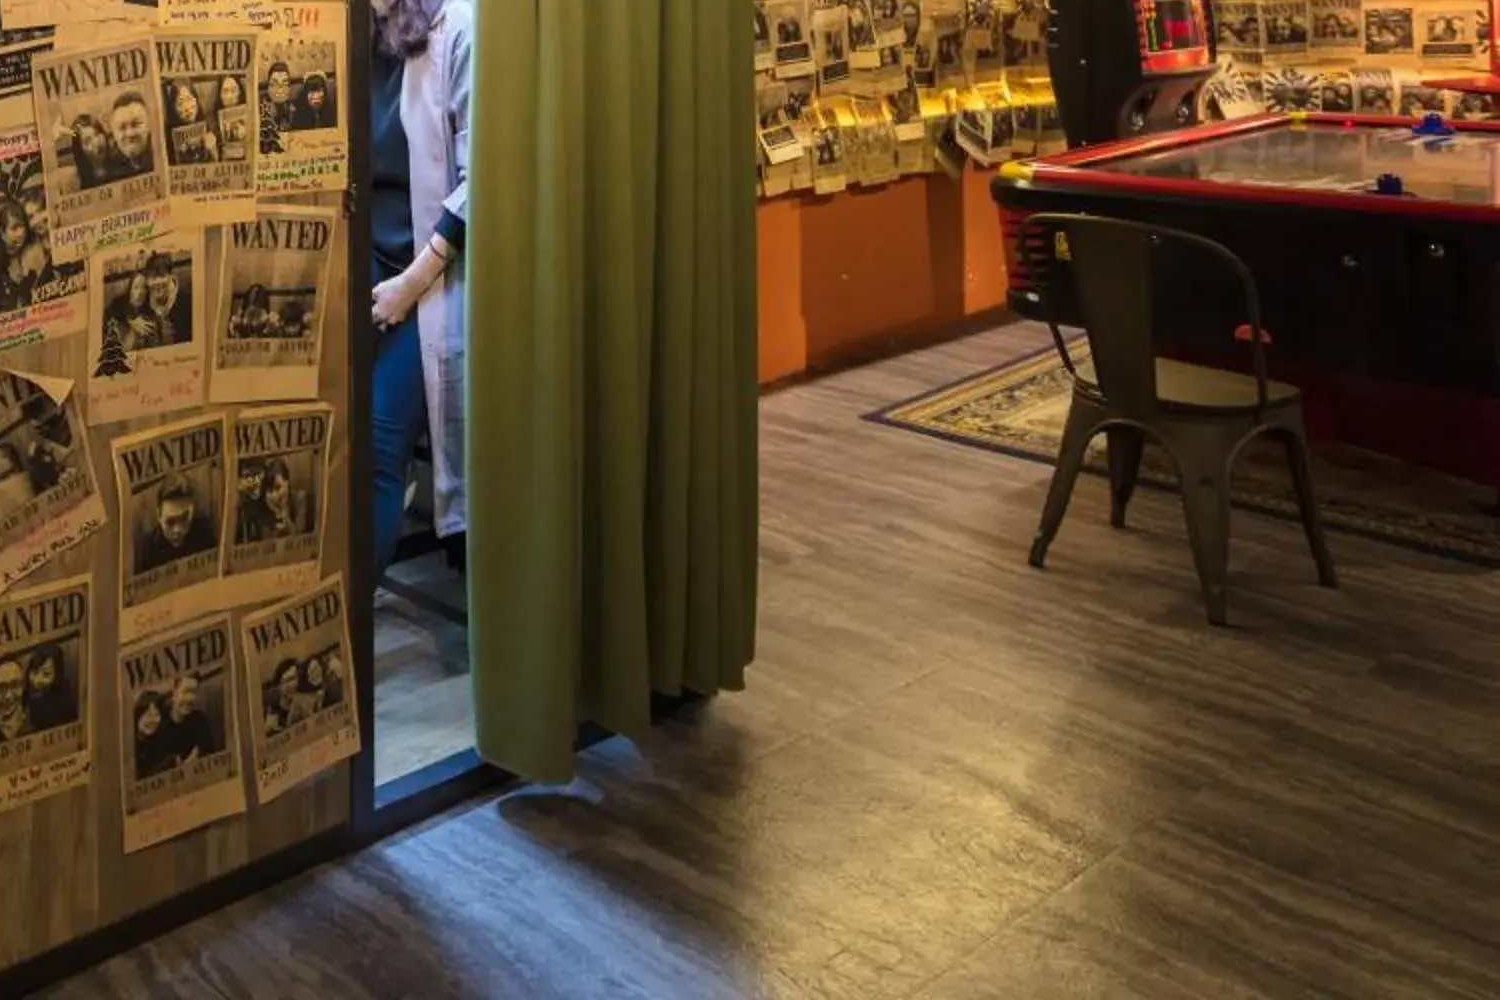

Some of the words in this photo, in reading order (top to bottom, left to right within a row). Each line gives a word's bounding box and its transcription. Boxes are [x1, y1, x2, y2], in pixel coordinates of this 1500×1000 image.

[39, 48, 147, 101] WANTED
[157, 40, 251, 72] WANTED
[232, 219, 329, 251] WANTED
[121, 429, 219, 481] WANTED
[234, 416, 324, 454] WANTED
[250, 592, 340, 653] WANTED
[125, 628, 226, 689] WANTED
